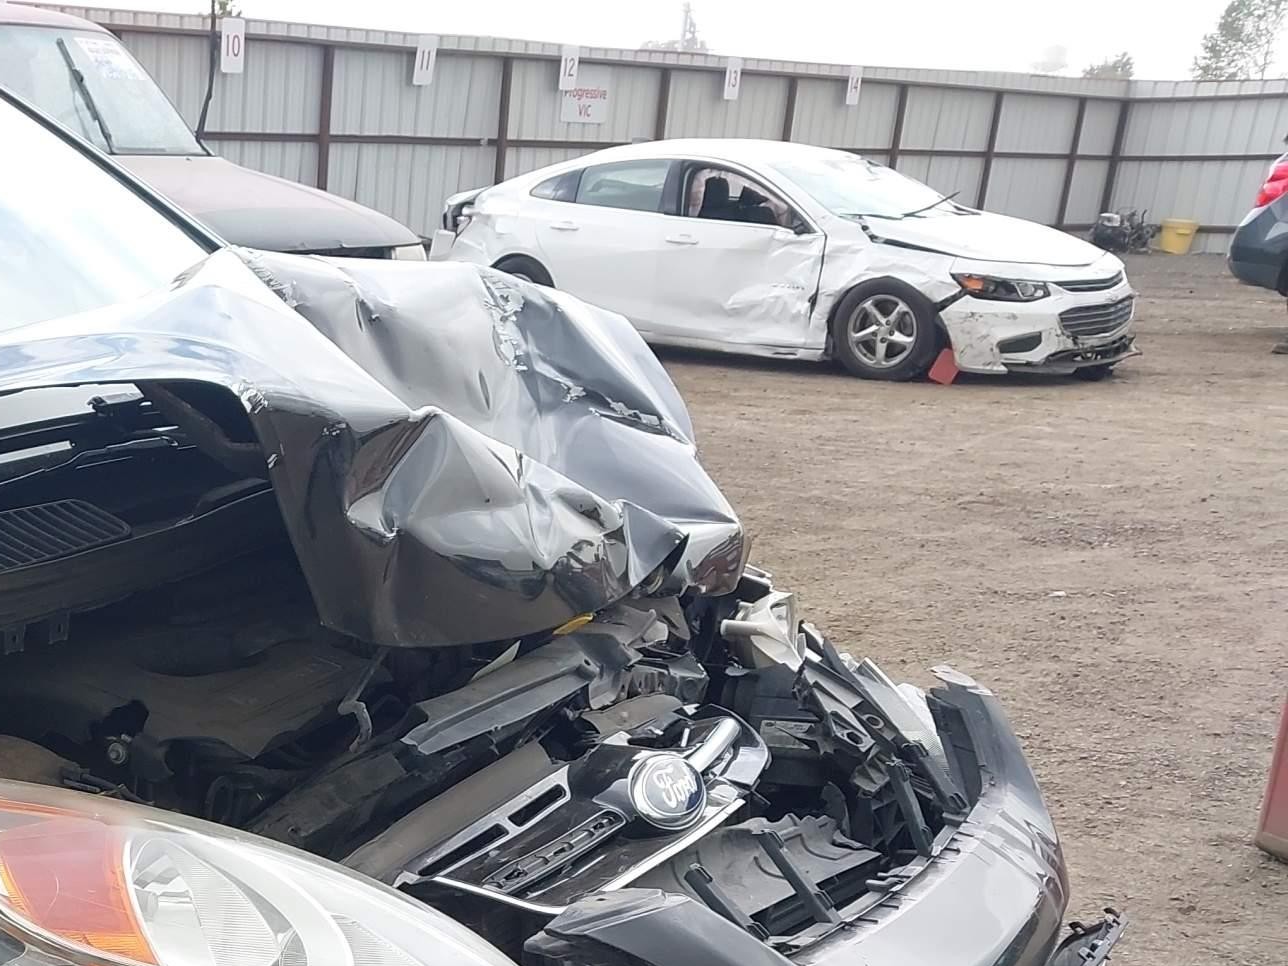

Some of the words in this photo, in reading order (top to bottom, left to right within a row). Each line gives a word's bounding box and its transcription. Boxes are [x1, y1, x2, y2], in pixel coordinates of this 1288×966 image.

[226, 34, 241, 57] 10
[420, 49, 431, 71] 11
[563, 57, 576, 77] 12
[728, 70, 737, 87] 13
[850, 77, 860, 94] 14
[564, 87, 608, 101] Progressive
[652, 763, 698, 808] Ford
